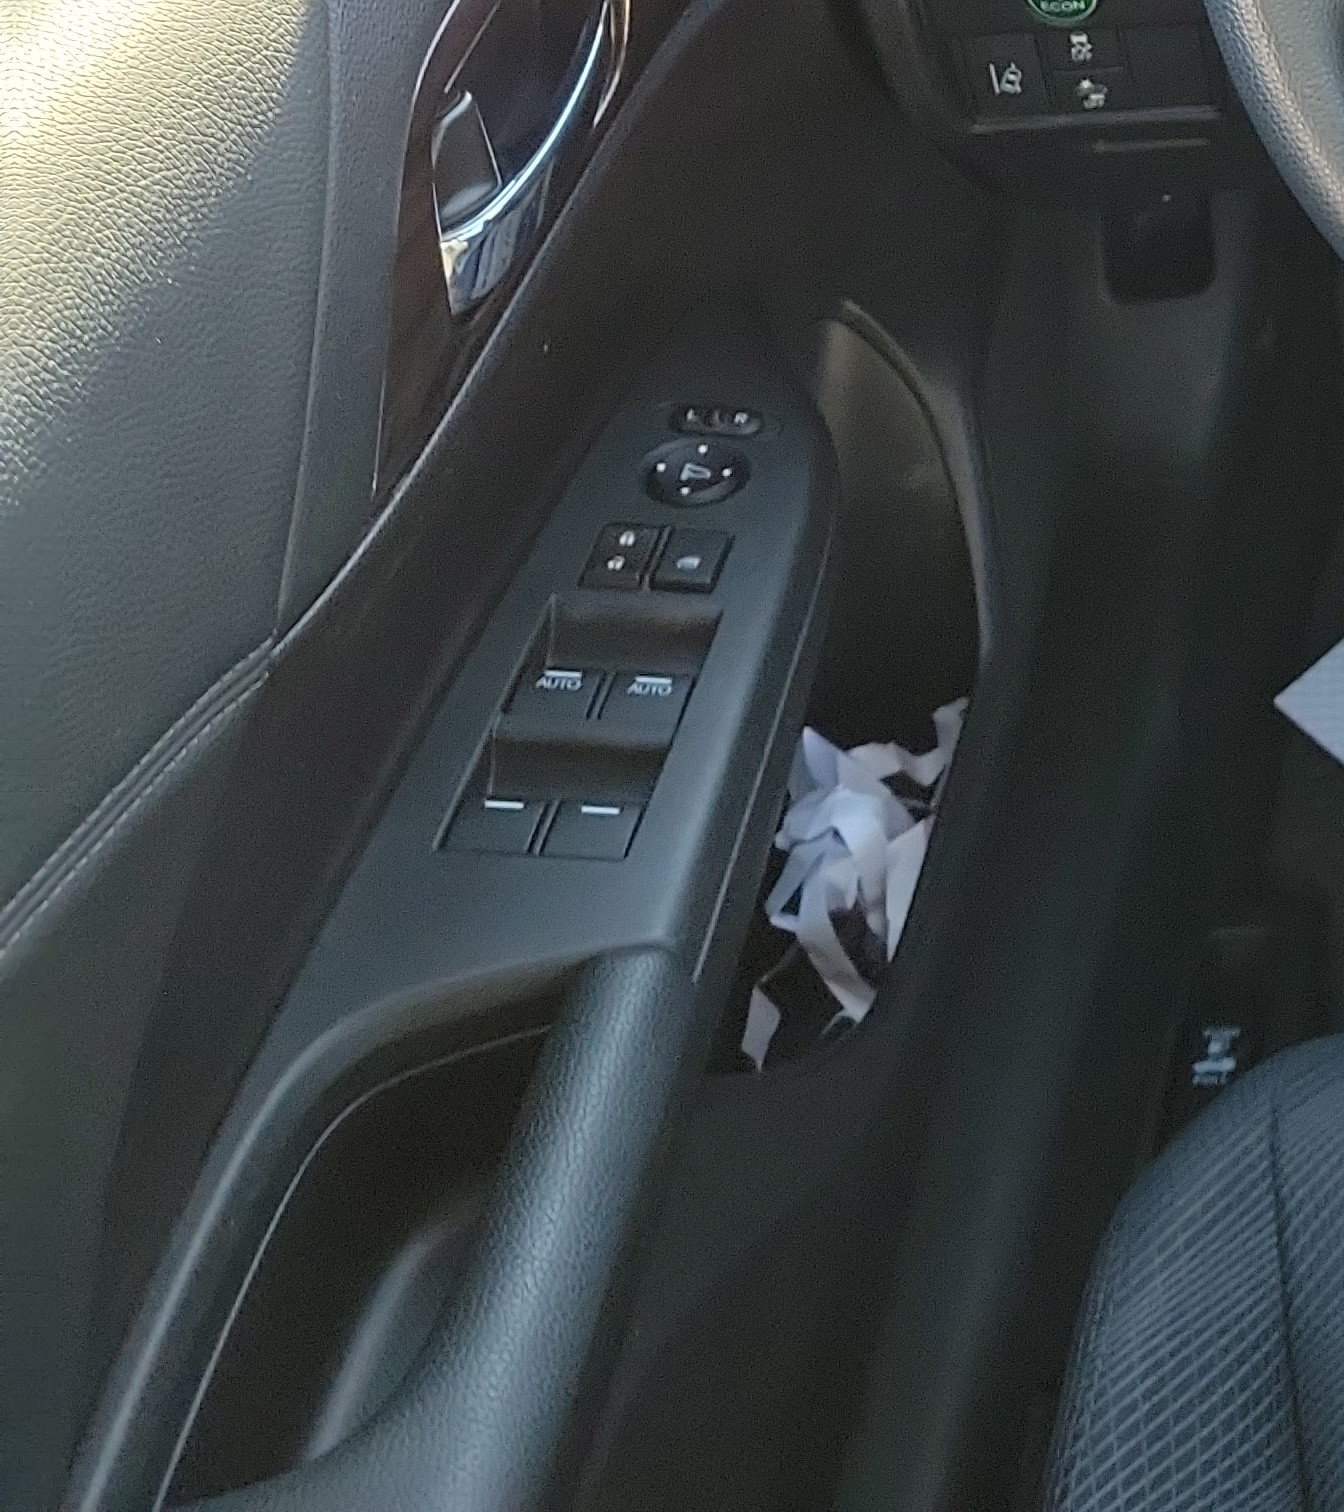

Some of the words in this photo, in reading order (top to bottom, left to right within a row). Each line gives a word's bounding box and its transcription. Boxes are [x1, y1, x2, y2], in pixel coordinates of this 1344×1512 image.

[1040, 0, 1086, 13] ECON
[535, 675, 582, 691] AUTO
[626, 682, 673, 697] AUTO
